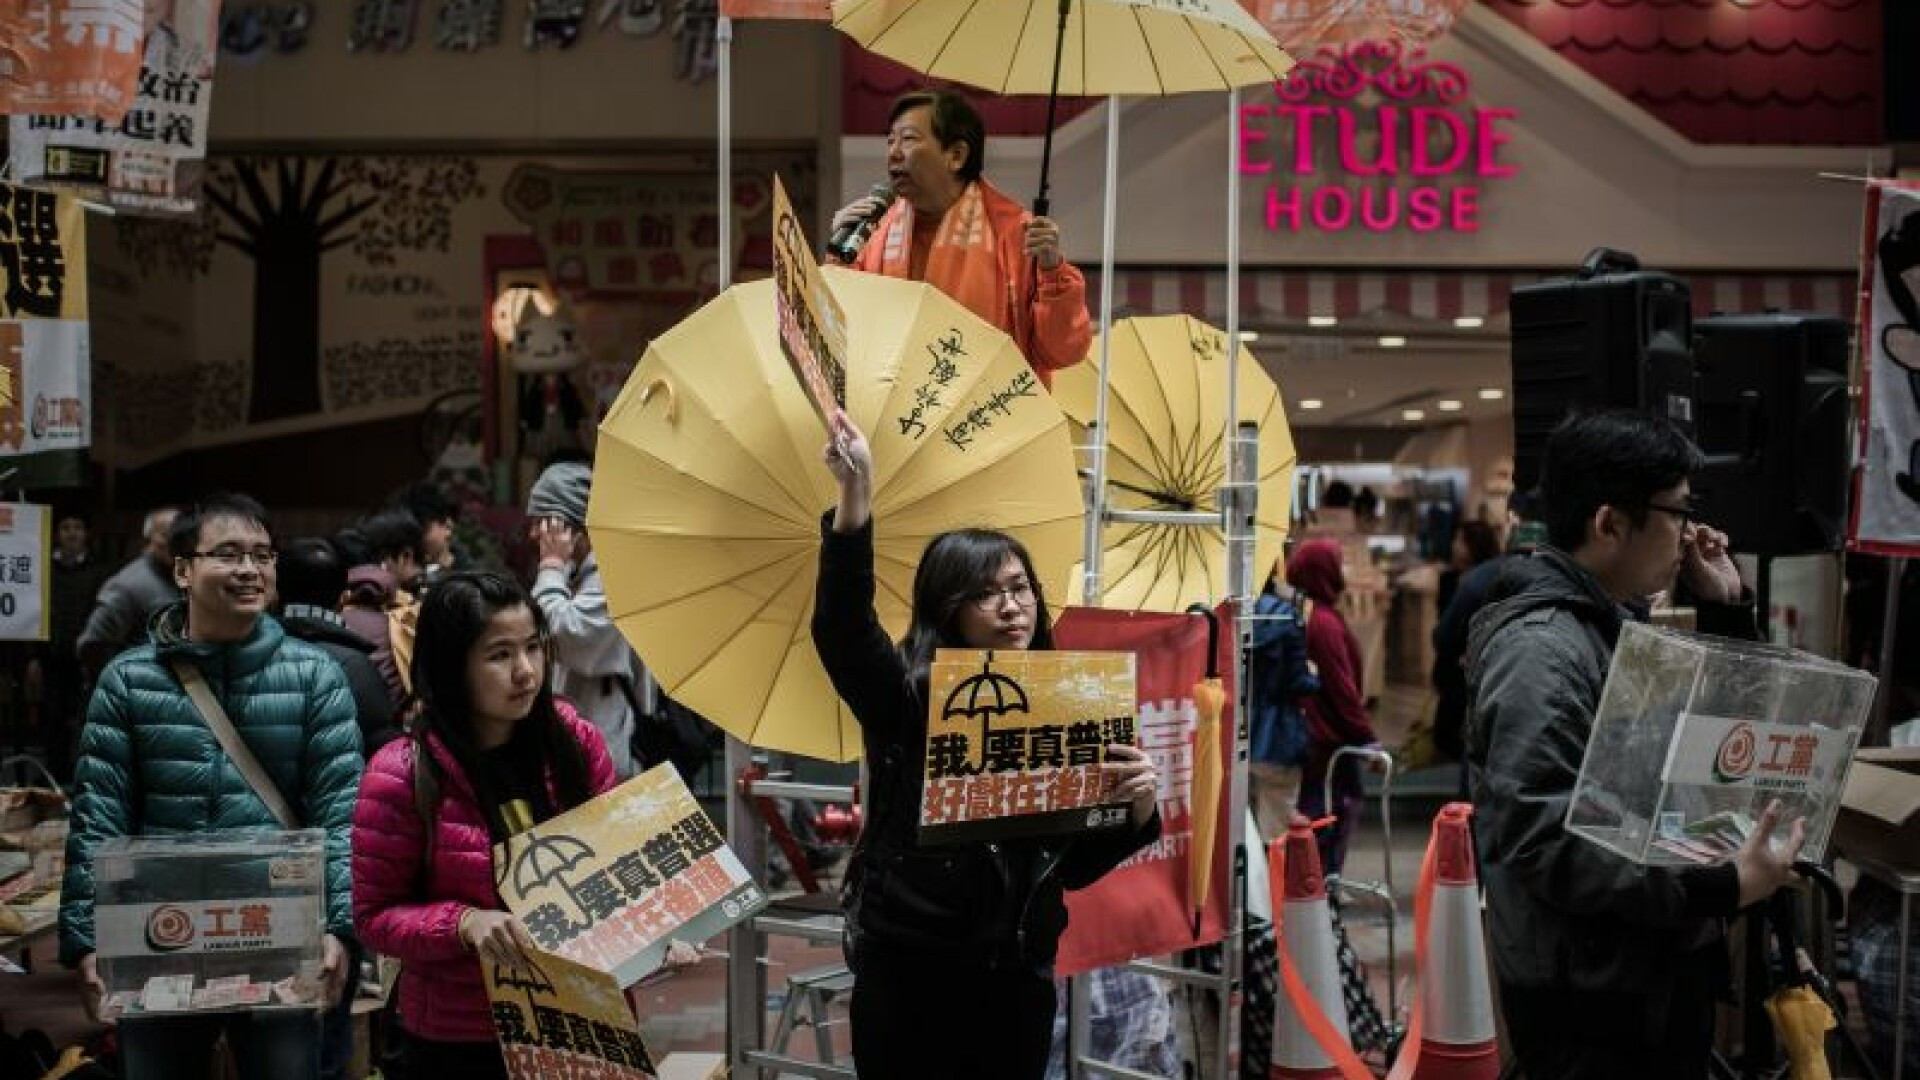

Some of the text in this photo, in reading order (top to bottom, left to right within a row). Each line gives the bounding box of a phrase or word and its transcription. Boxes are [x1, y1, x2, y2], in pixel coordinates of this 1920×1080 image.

[1264, 185, 1481, 232] HOUSE
[501, 810, 725, 952] 我要真普選
[203, 904, 272, 937] 工黨
